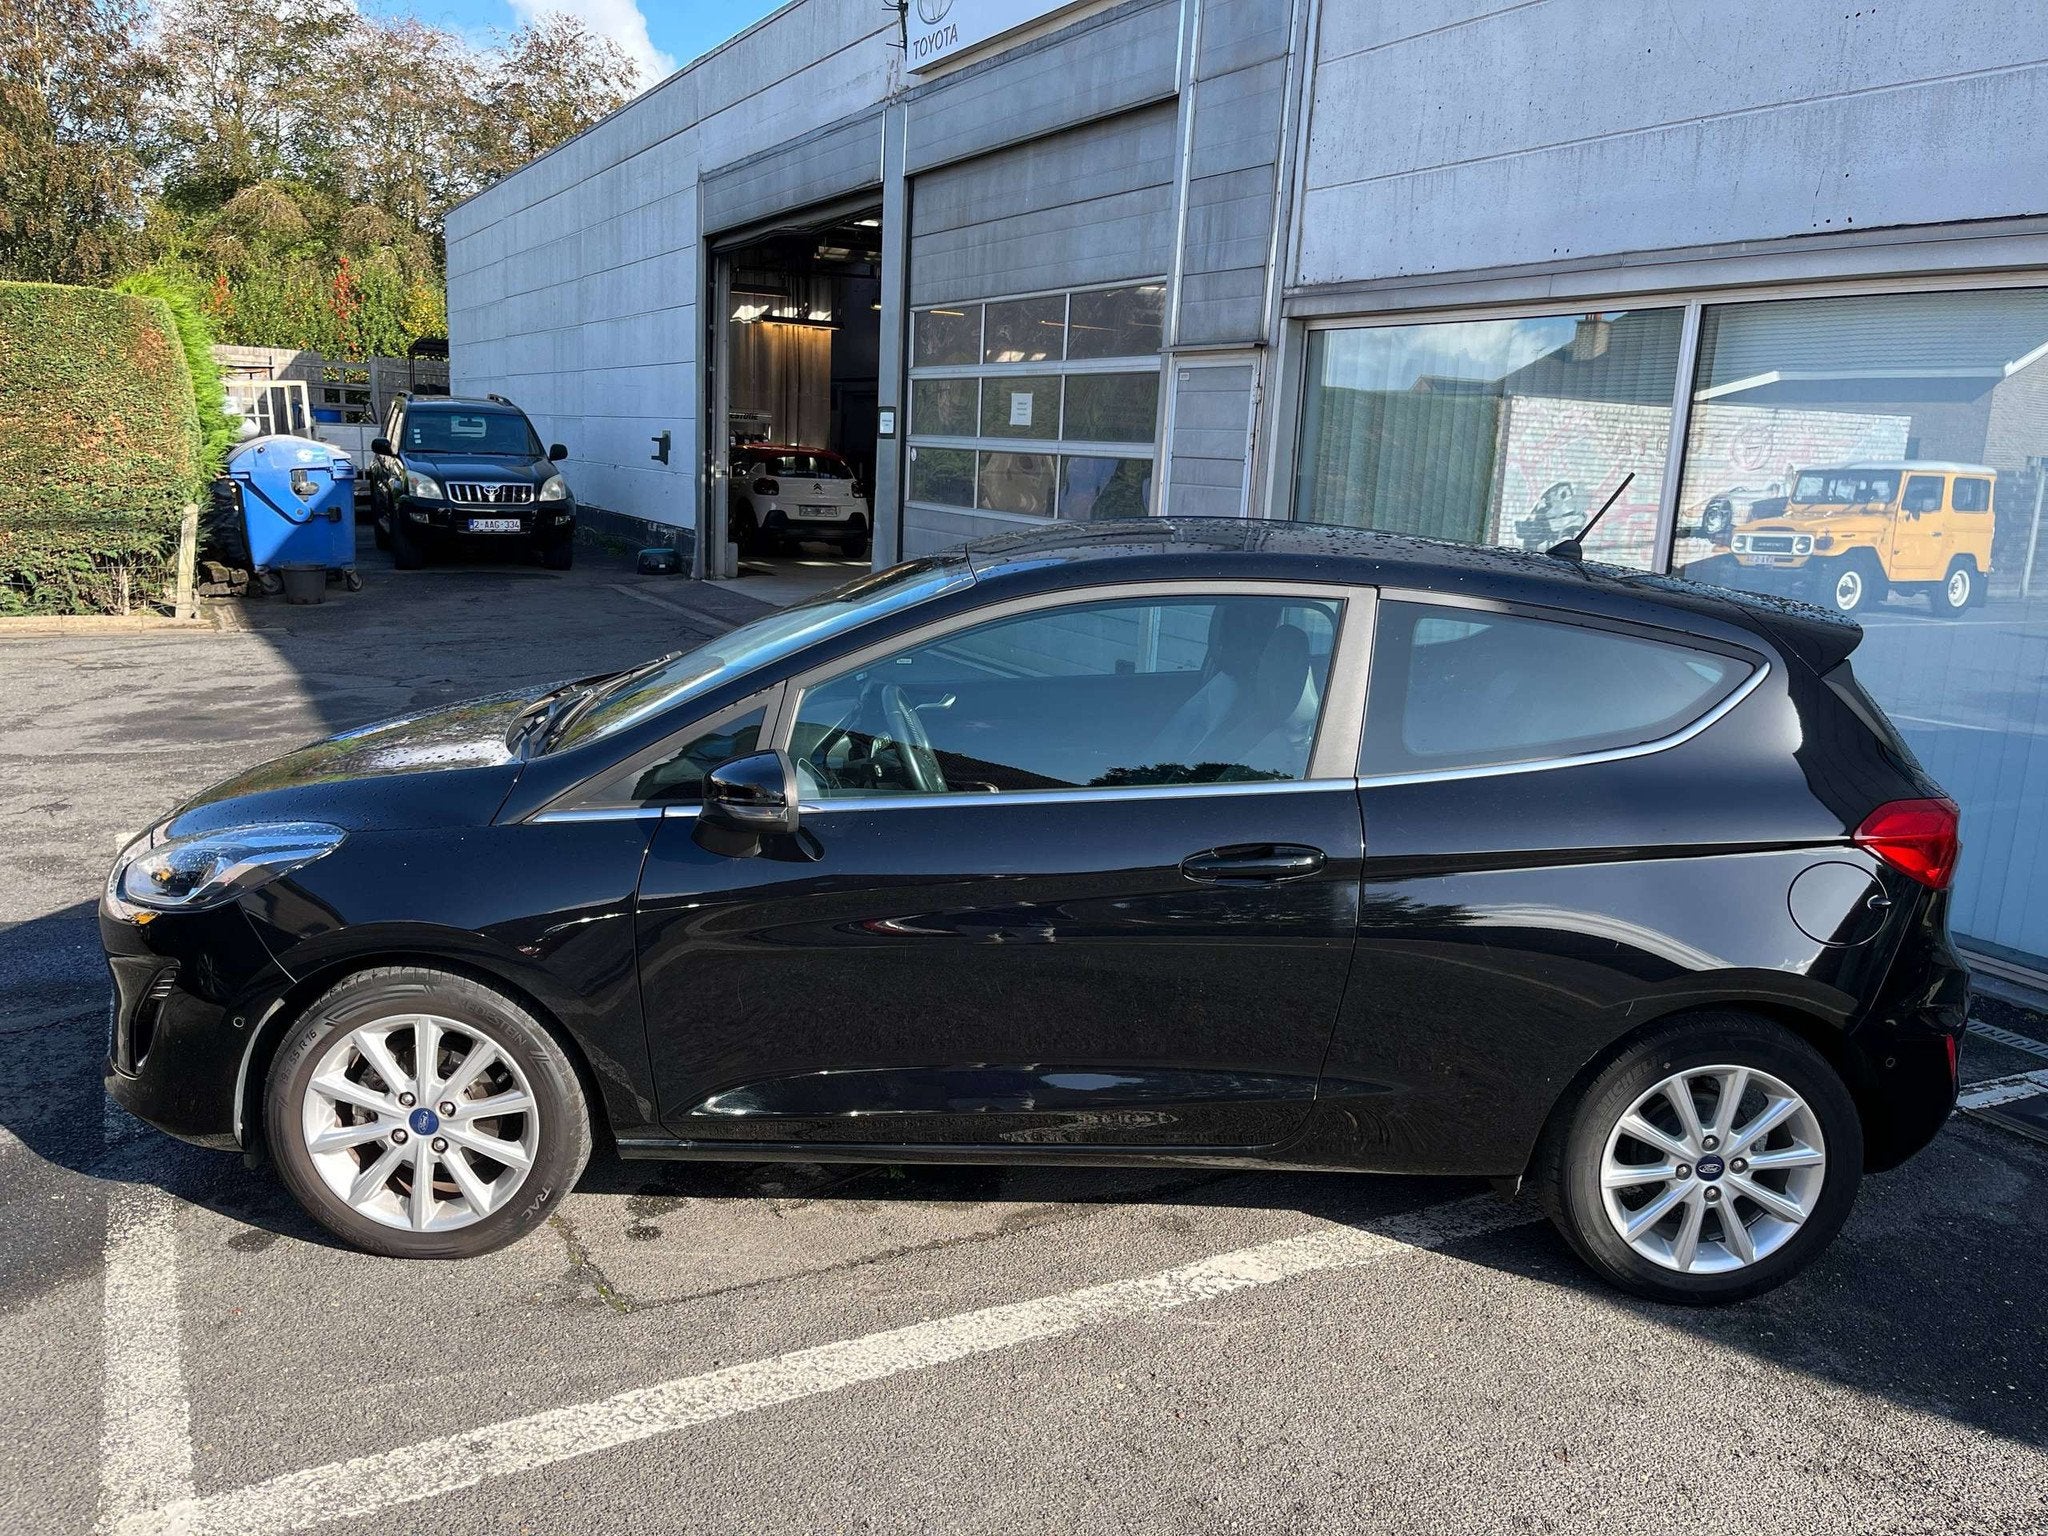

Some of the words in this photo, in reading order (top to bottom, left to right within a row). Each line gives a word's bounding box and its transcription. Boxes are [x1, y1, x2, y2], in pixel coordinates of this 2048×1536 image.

[913, 23, 958, 60] TOYOTA
[299, 1039, 308, 1051] R
[305, 1028, 317, 1042] 16
[1700, 1164, 1719, 1172] Ford
